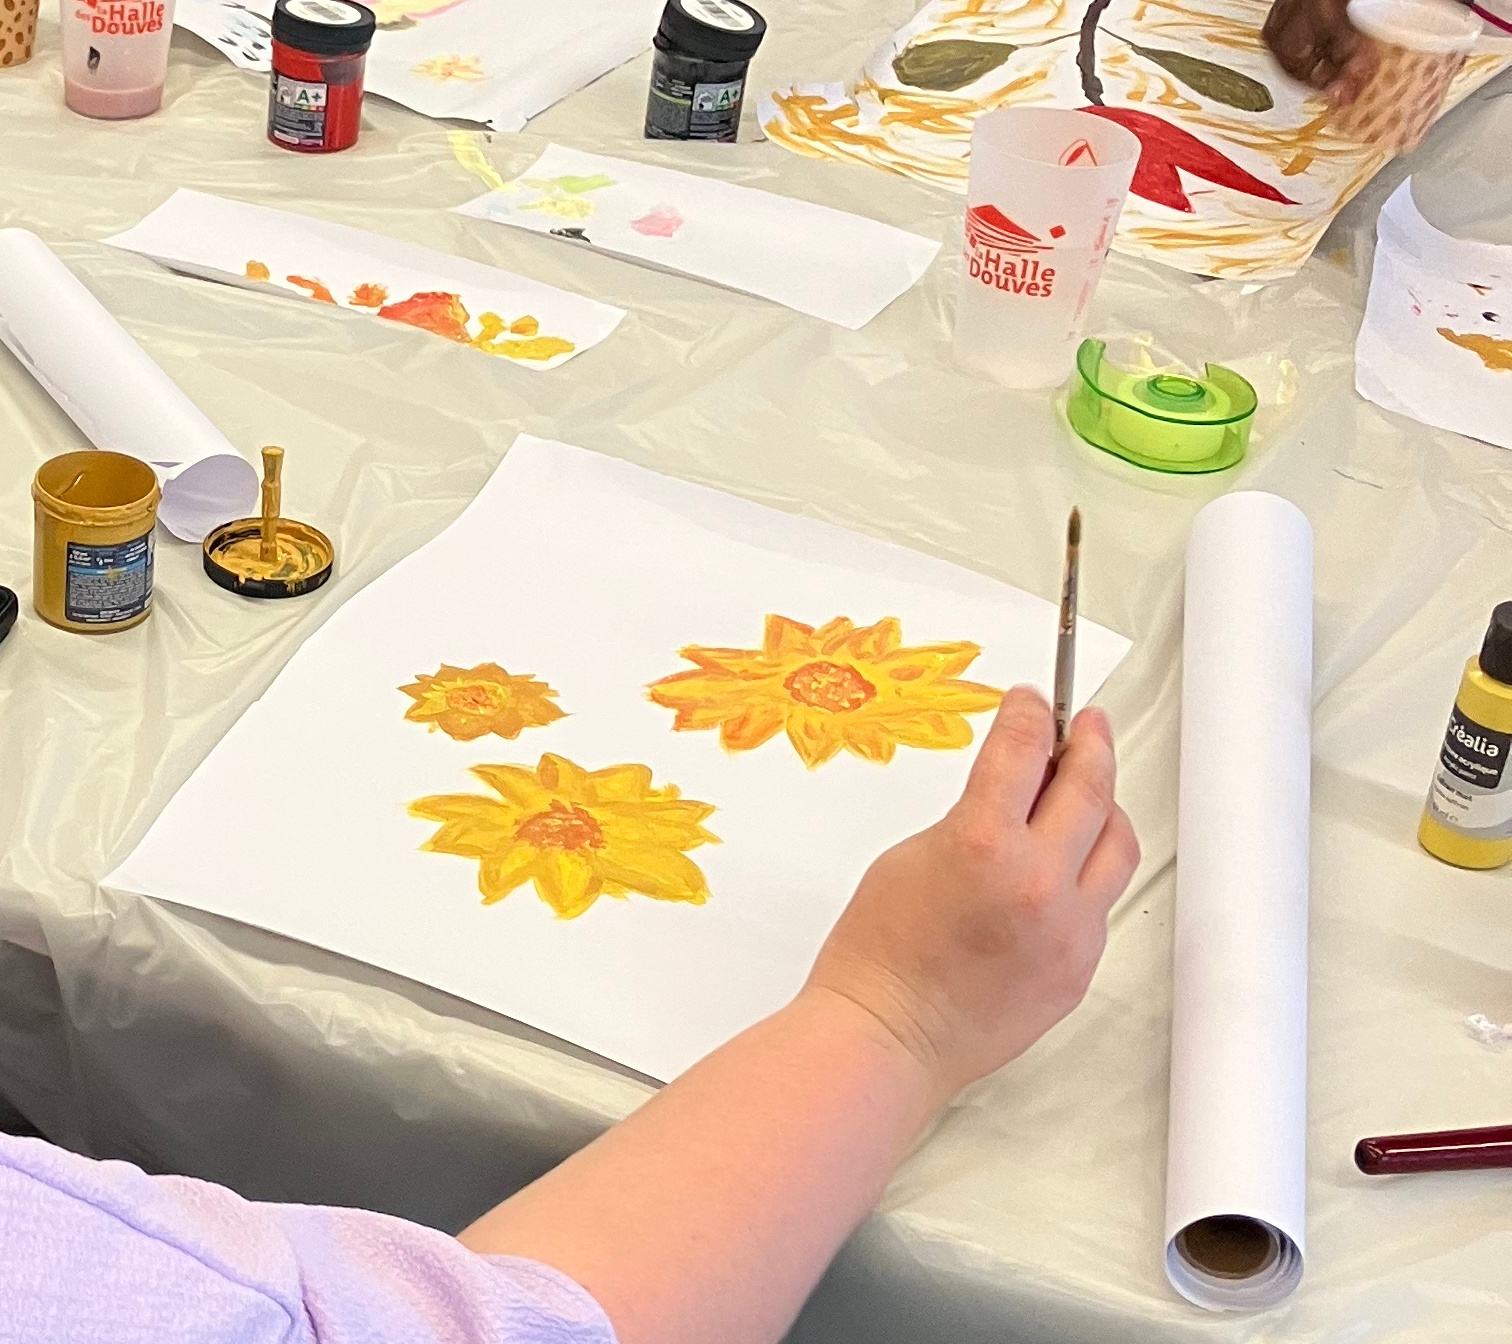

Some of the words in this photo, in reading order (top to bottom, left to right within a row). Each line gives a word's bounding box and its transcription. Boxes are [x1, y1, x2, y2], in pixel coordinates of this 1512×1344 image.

[110, 1, 165, 23] Halle
[92, 16, 164, 35] Douves
[297, 89, 322, 104] A+
[969, 256, 1053, 297] Douves
[984, 249, 1056, 282] Halle
